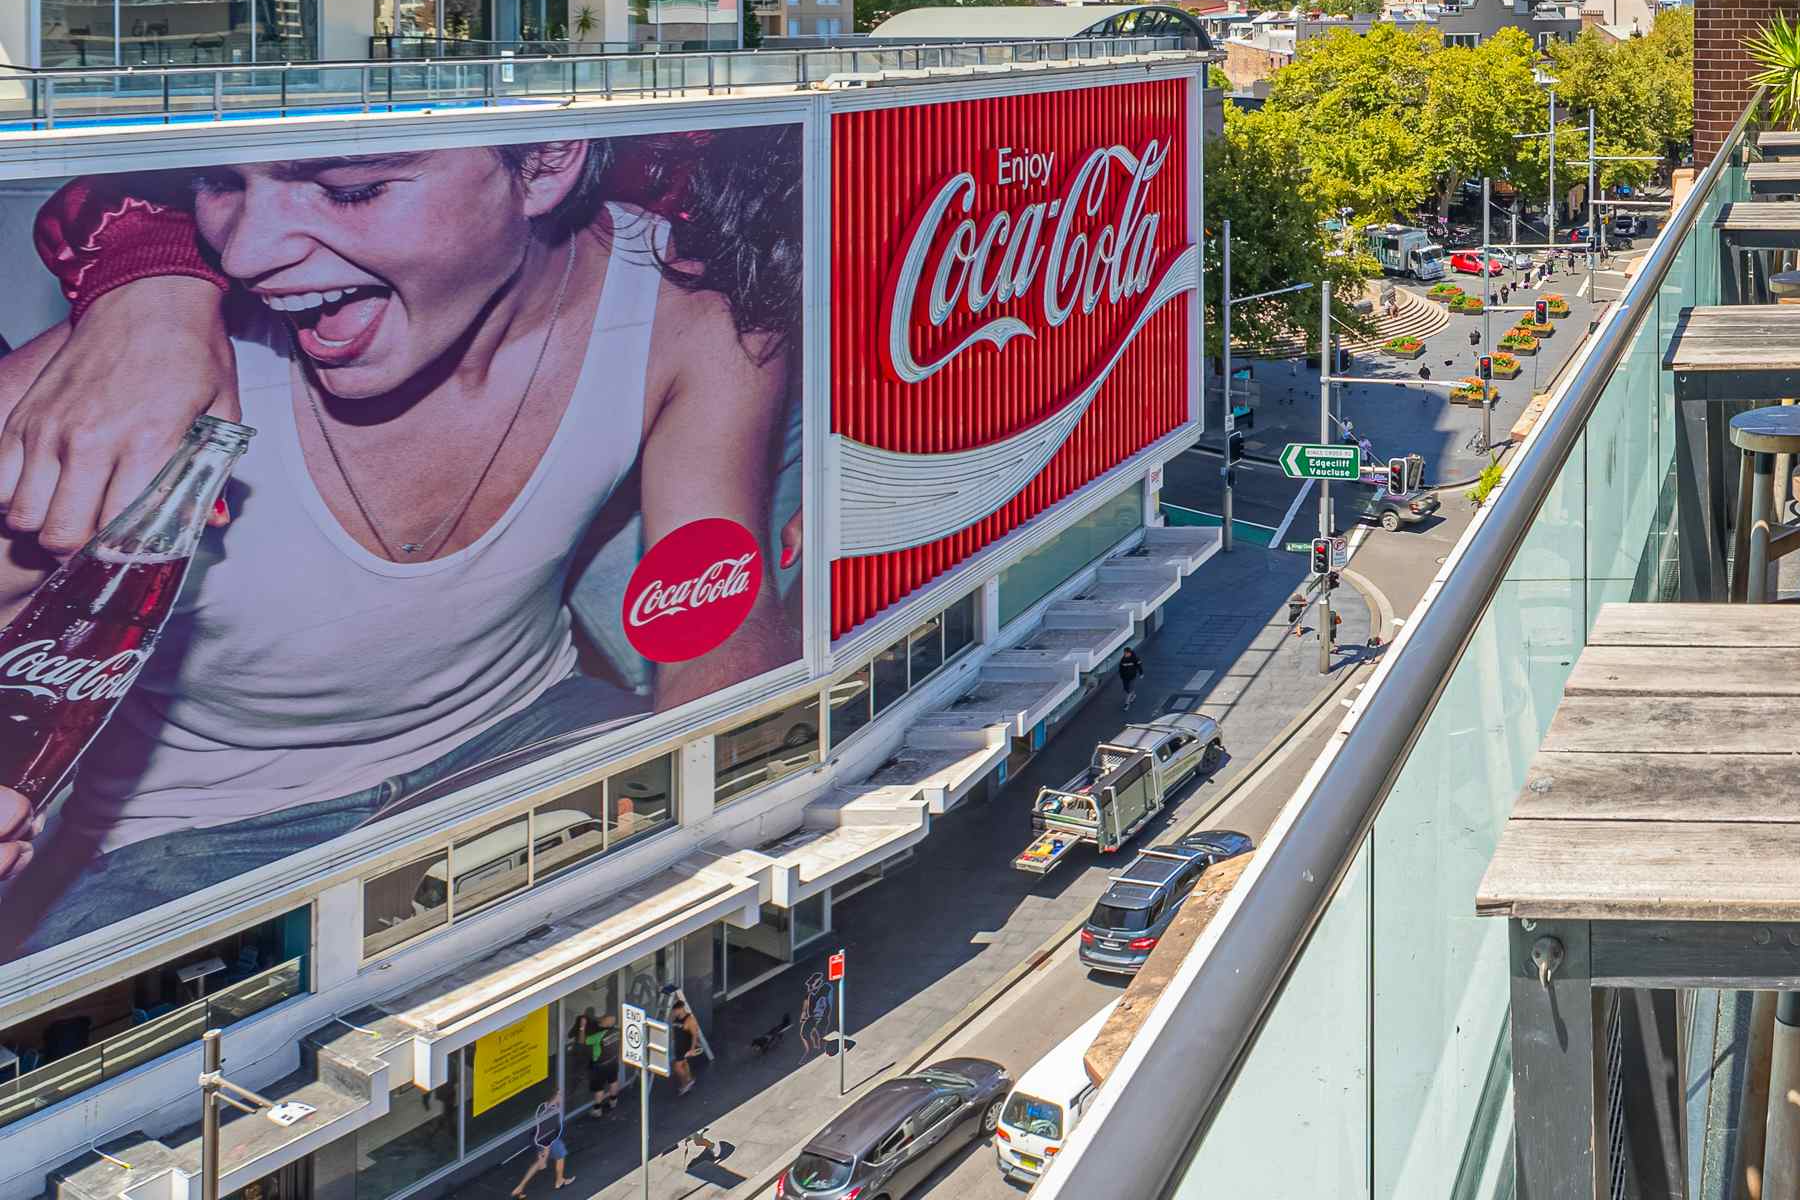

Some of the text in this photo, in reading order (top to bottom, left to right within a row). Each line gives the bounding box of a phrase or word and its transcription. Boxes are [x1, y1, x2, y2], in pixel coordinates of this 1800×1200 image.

[998, 148, 1054, 189] Enjoy
[889, 136, 1171, 384] Coca-Cola
[1309, 458, 1350, 469] Edgecliff
[1310, 468, 1351, 477] Vaucluse
[629, 550, 757, 627] Coca-Cola
[625, 1008, 641, 1023] END
[628, 1029, 640, 1044] 40
[625, 1049, 641, 1061] AREA
